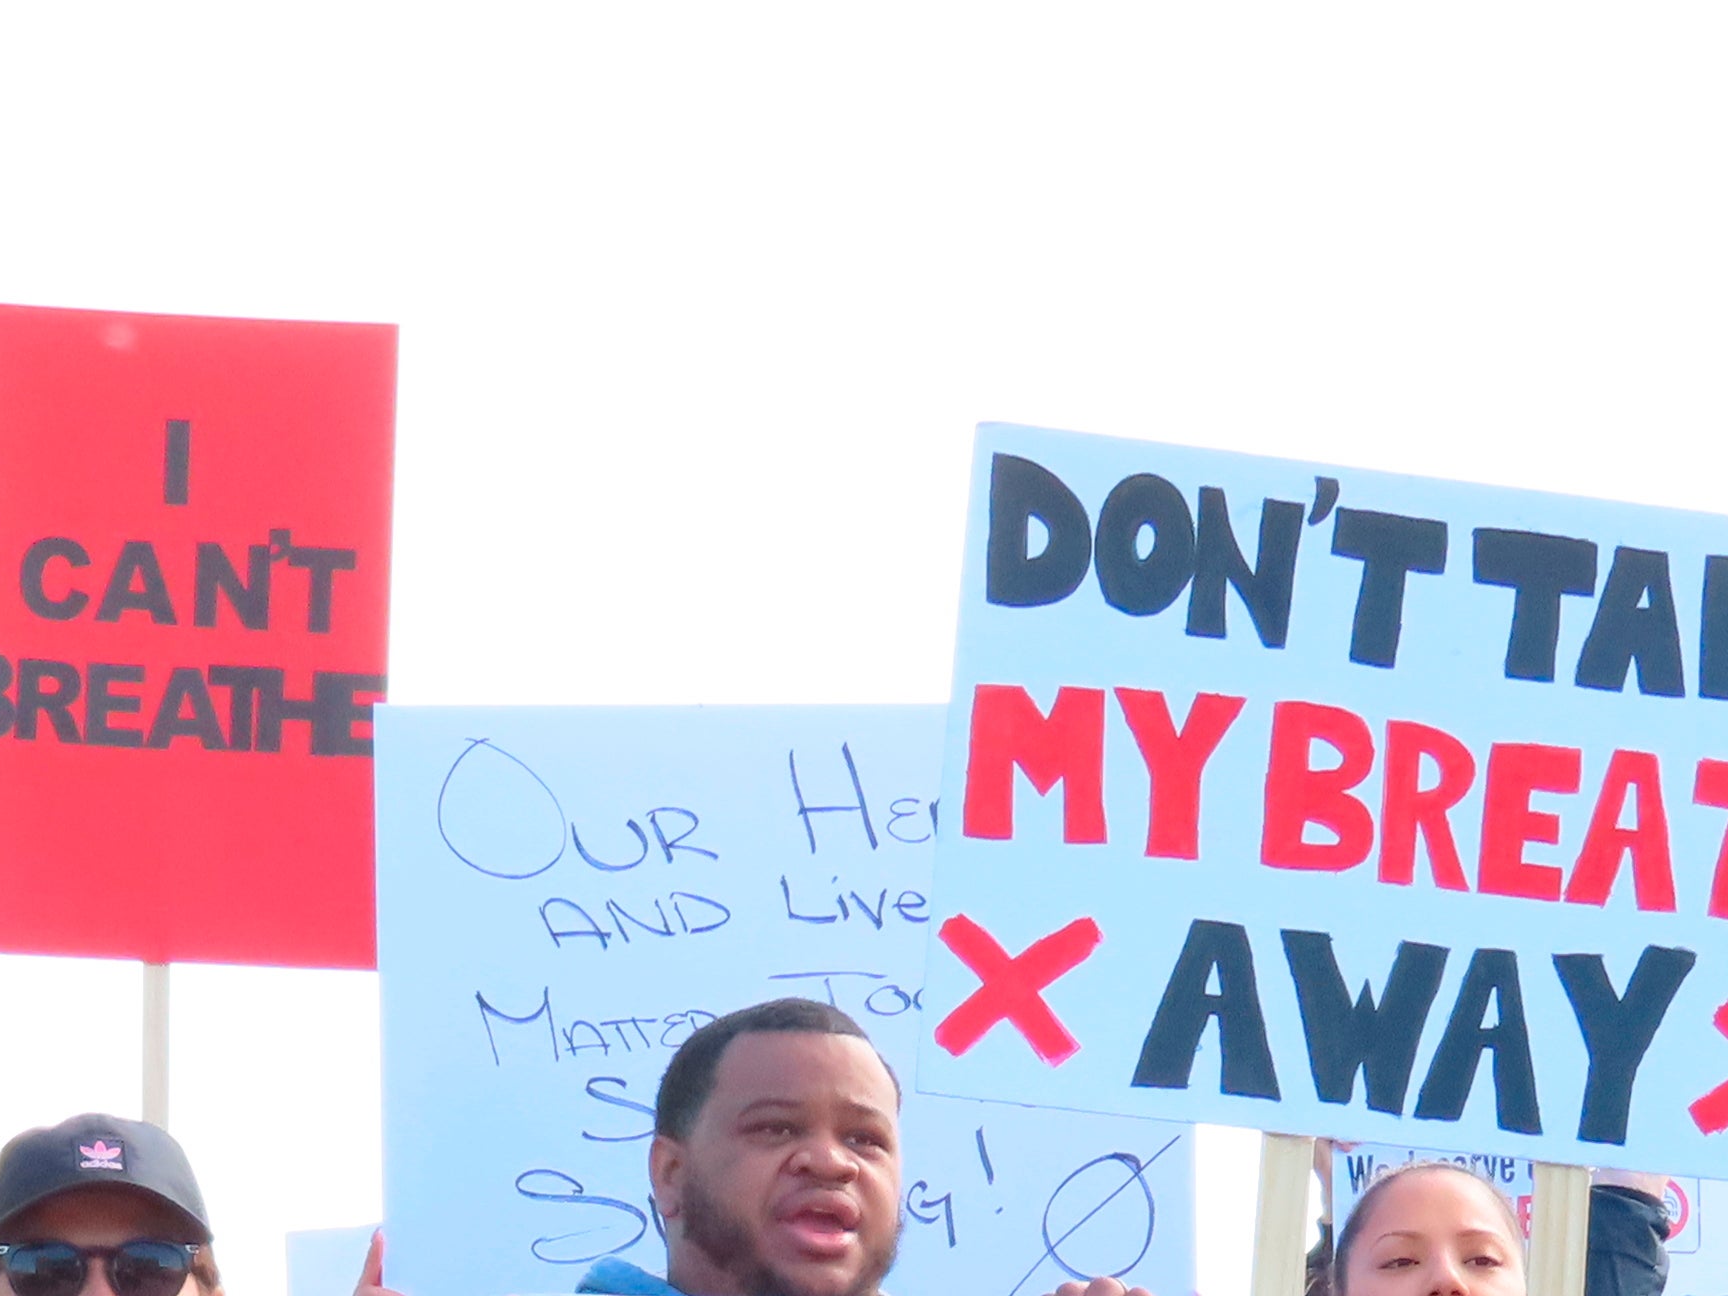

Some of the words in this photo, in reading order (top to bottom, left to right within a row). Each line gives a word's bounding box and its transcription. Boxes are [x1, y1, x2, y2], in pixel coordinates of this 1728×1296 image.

[163, 419, 191, 505] I
[19, 527, 357, 634] CAN'T
[984, 451, 1449, 669] DON'T
[962, 683, 1247, 861] MY
[538, 890, 731, 949] AND
[1129, 917, 1698, 1146] AWAY
